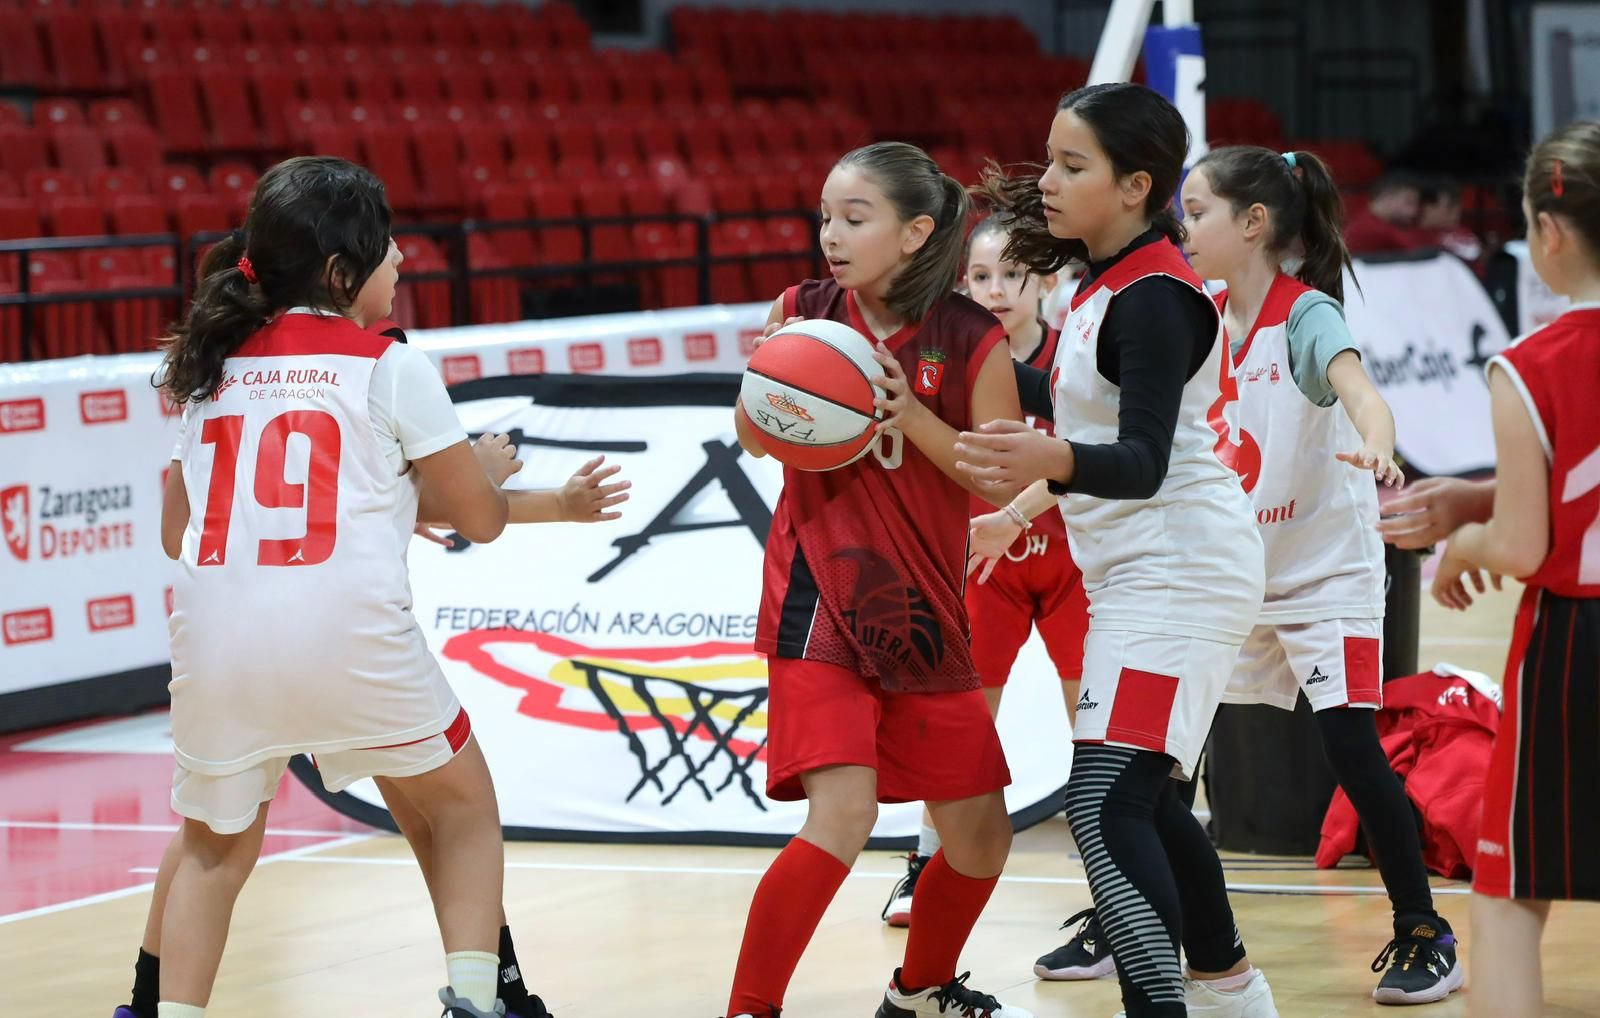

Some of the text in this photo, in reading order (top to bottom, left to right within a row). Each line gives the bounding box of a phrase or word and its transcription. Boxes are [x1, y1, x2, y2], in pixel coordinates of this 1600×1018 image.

[242, 369, 340, 386] CAJA RURAL
[249, 386, 325, 400] DE ARAGÓN
[39, 484, 131, 525] Zaragoza
[197, 409, 341, 566] 19
[1255, 498, 1296, 525] ont
[40, 522, 133, 560] DEPORTE
[434, 603, 758, 639] FEDERACIÓN ARAGONES
